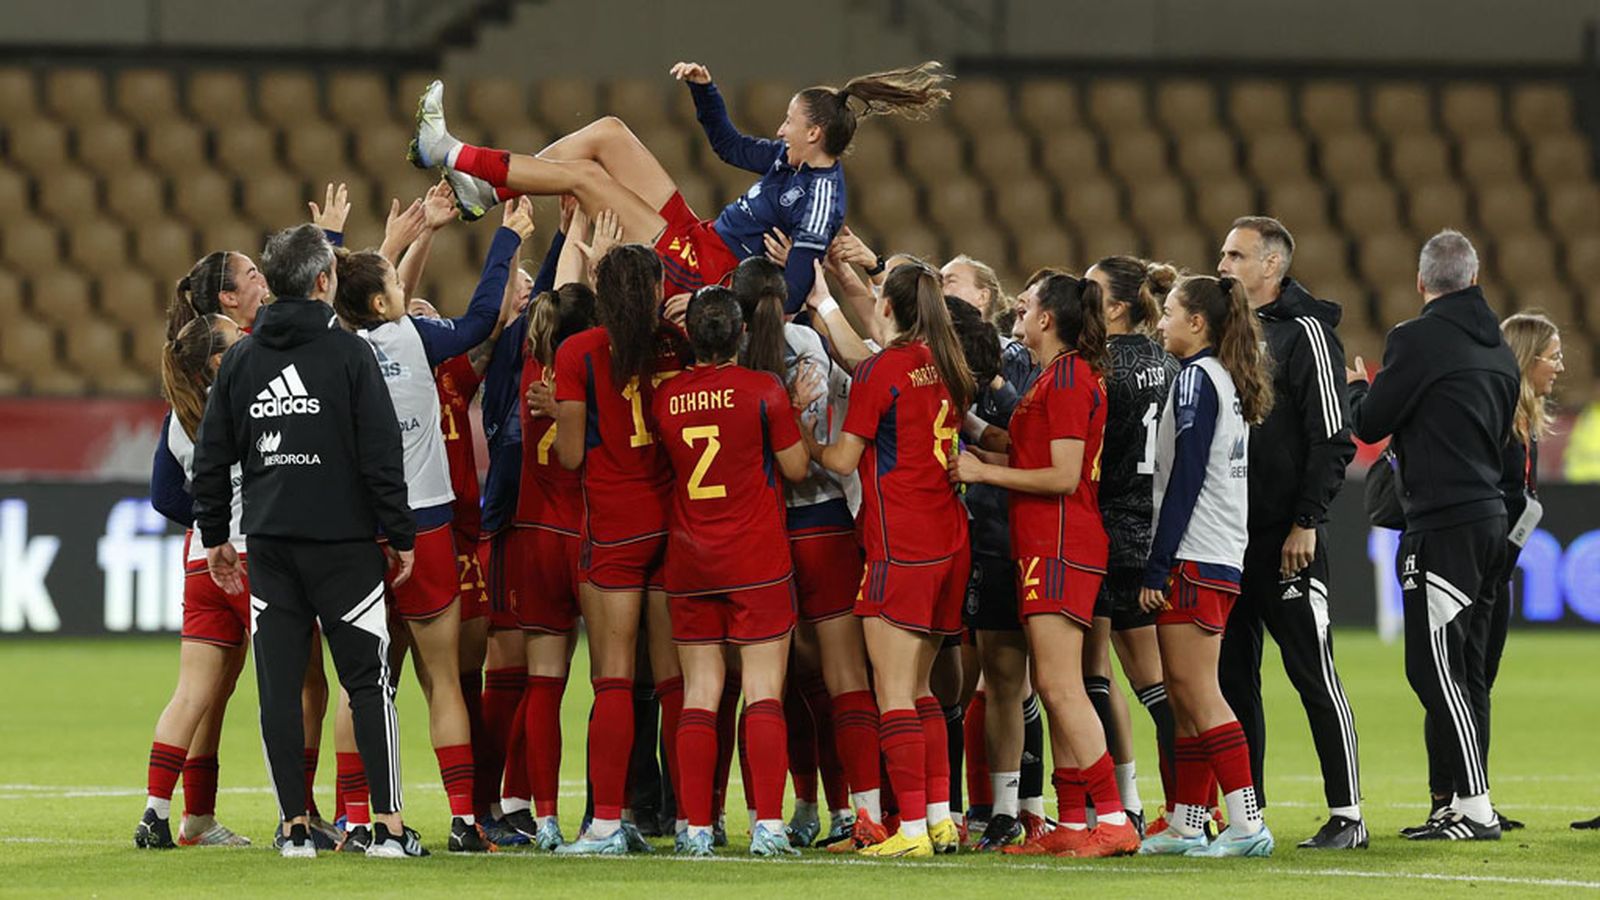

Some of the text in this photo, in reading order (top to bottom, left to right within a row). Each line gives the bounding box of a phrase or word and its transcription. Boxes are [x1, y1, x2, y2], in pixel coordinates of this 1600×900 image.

[1135, 366, 1165, 390] MISA
[249, 395, 321, 418] adidas
[669, 389, 735, 415] OIHANE
[682, 425, 727, 500] 2
